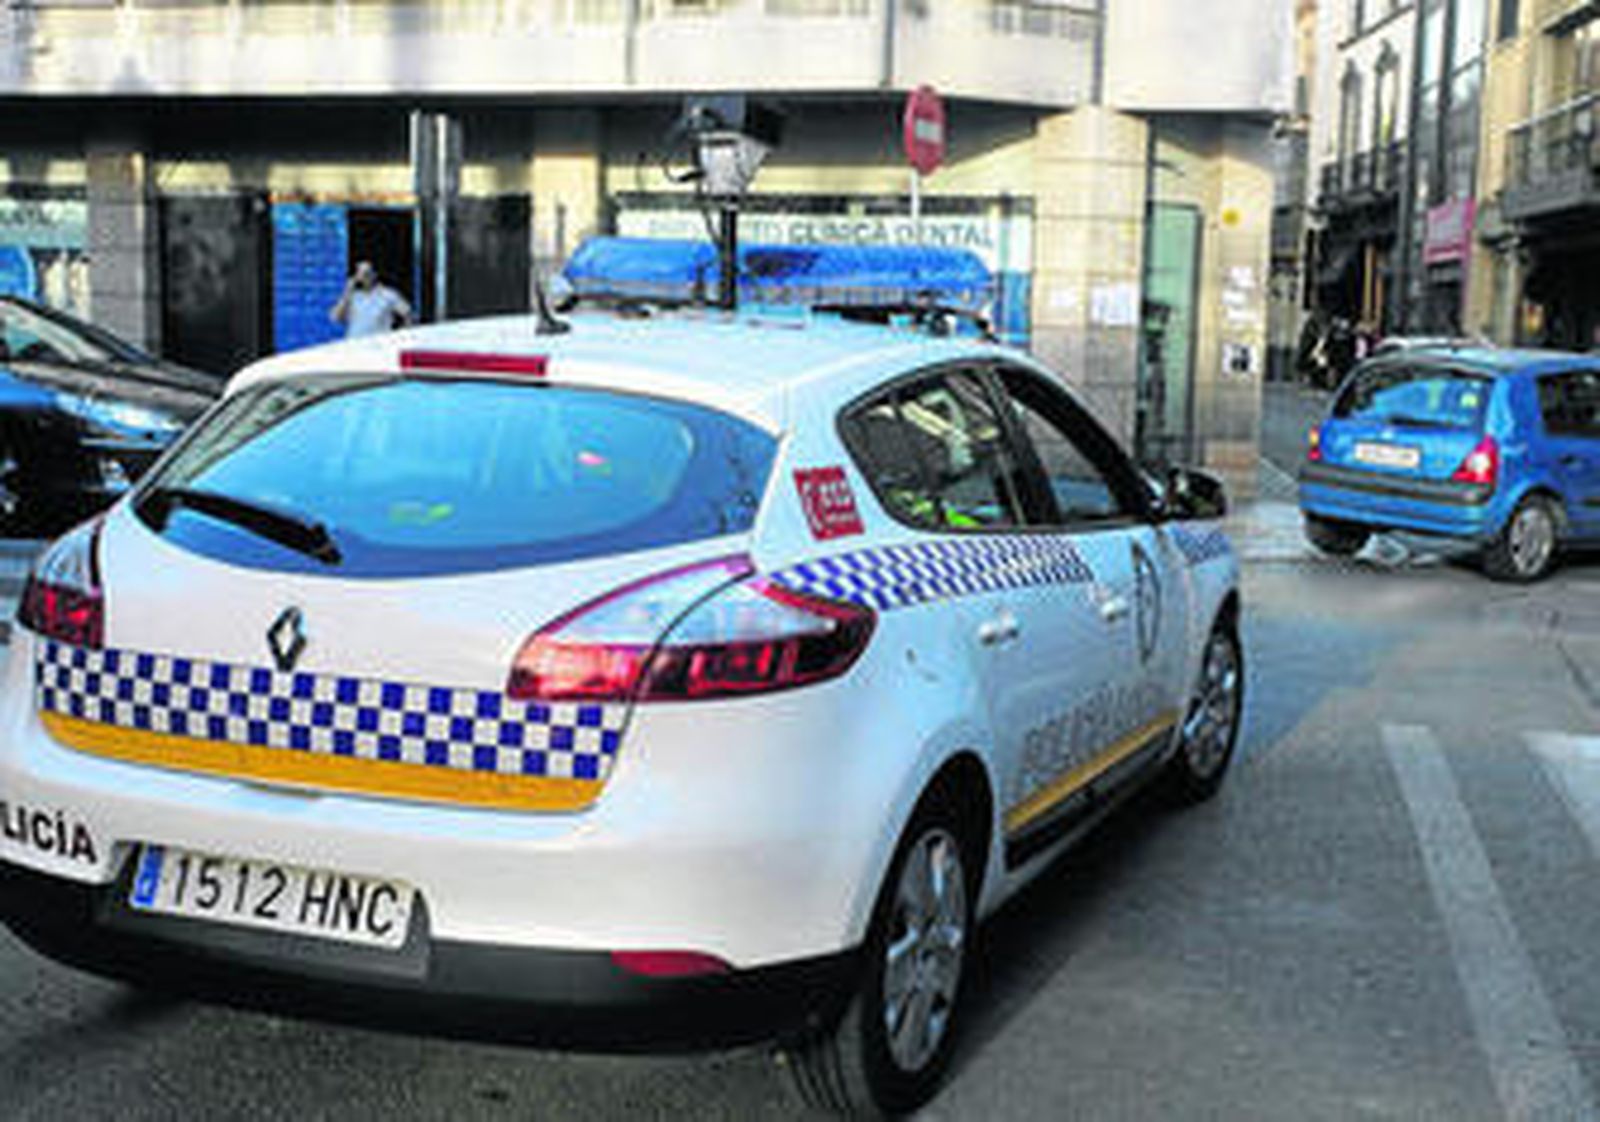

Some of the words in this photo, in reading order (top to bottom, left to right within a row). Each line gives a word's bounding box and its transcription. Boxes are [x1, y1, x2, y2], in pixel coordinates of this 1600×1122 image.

[897, 222, 994, 248] DENTAL
[175, 852, 287, 920] 1512
[299, 870, 397, 935] HNC
